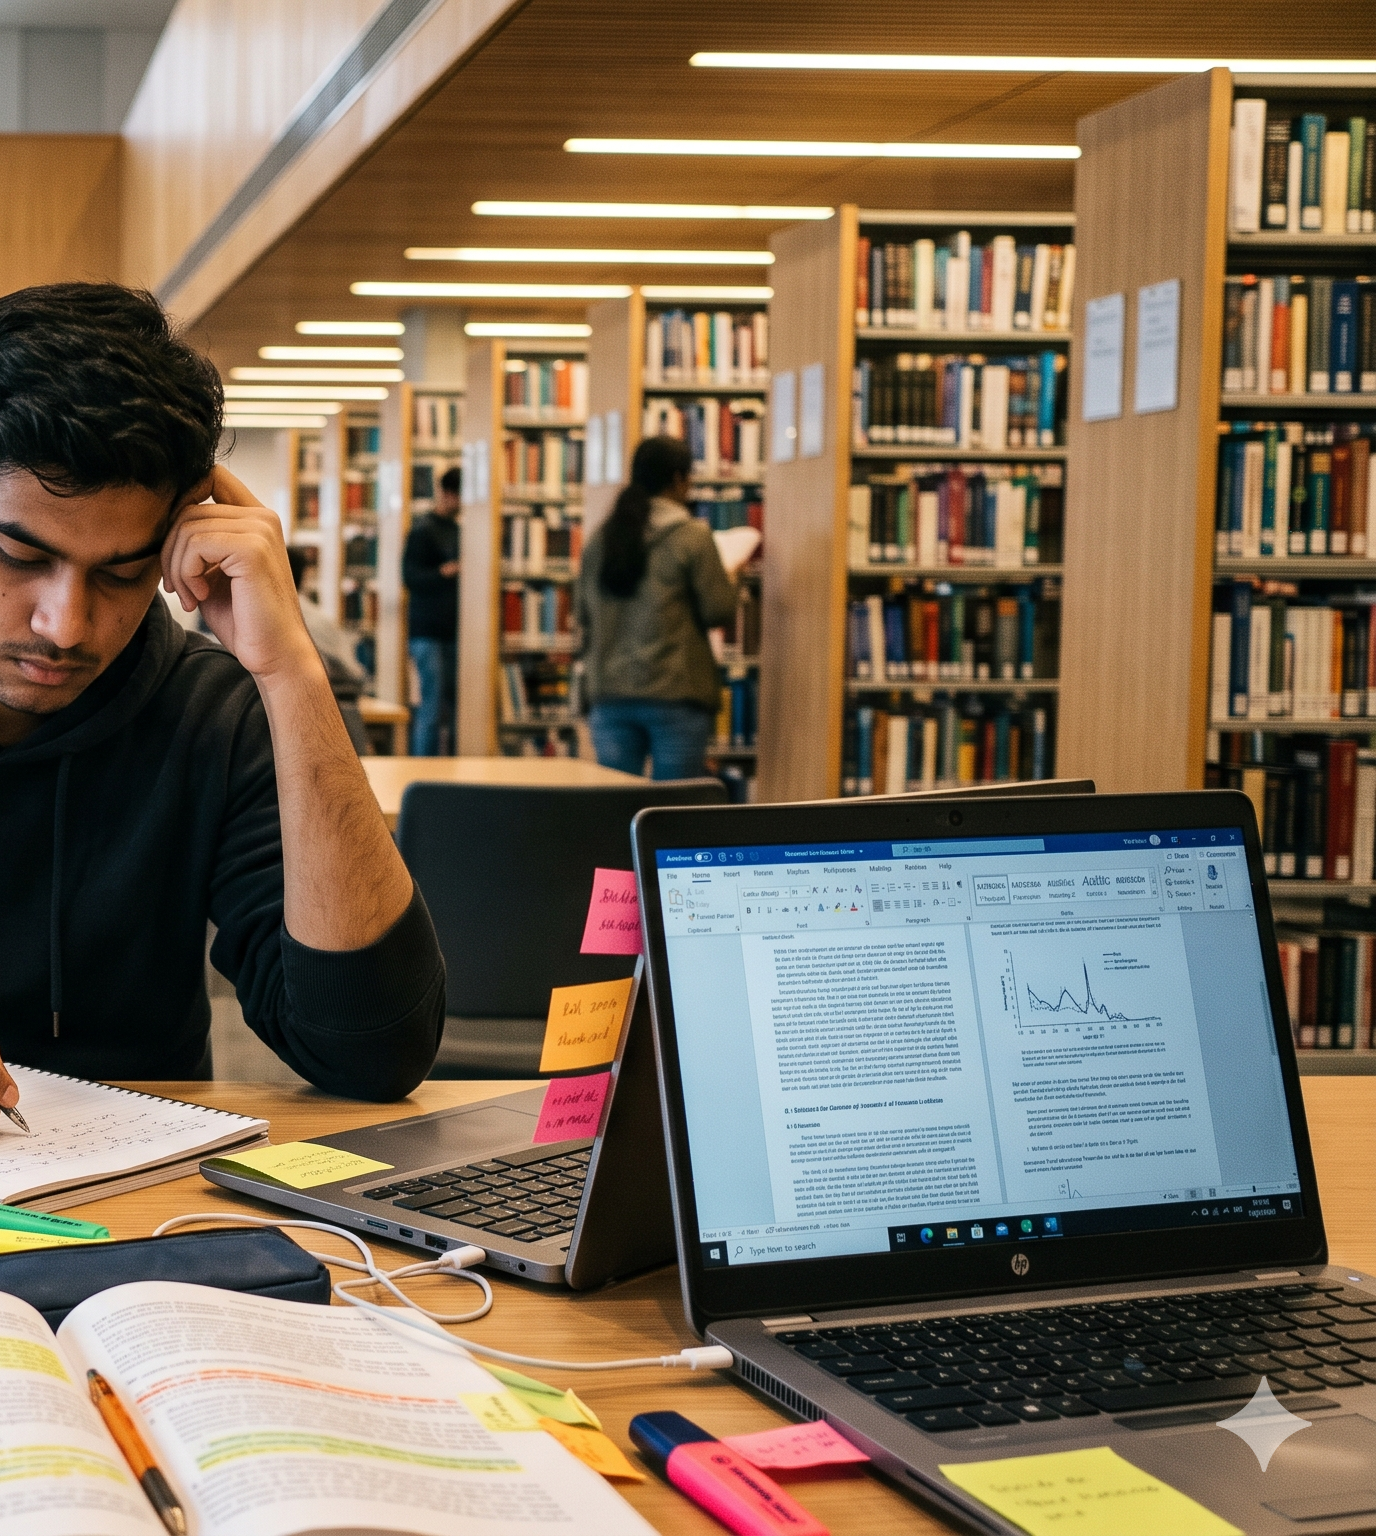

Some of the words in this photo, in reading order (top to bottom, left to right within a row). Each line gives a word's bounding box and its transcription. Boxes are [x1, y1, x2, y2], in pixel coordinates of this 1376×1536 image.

[749, 1246, 765, 1257] Type
[785, 1244, 793, 1252] to
[794, 1242, 817, 1251] search
[1012, 1254, 1029, 1276] hp
